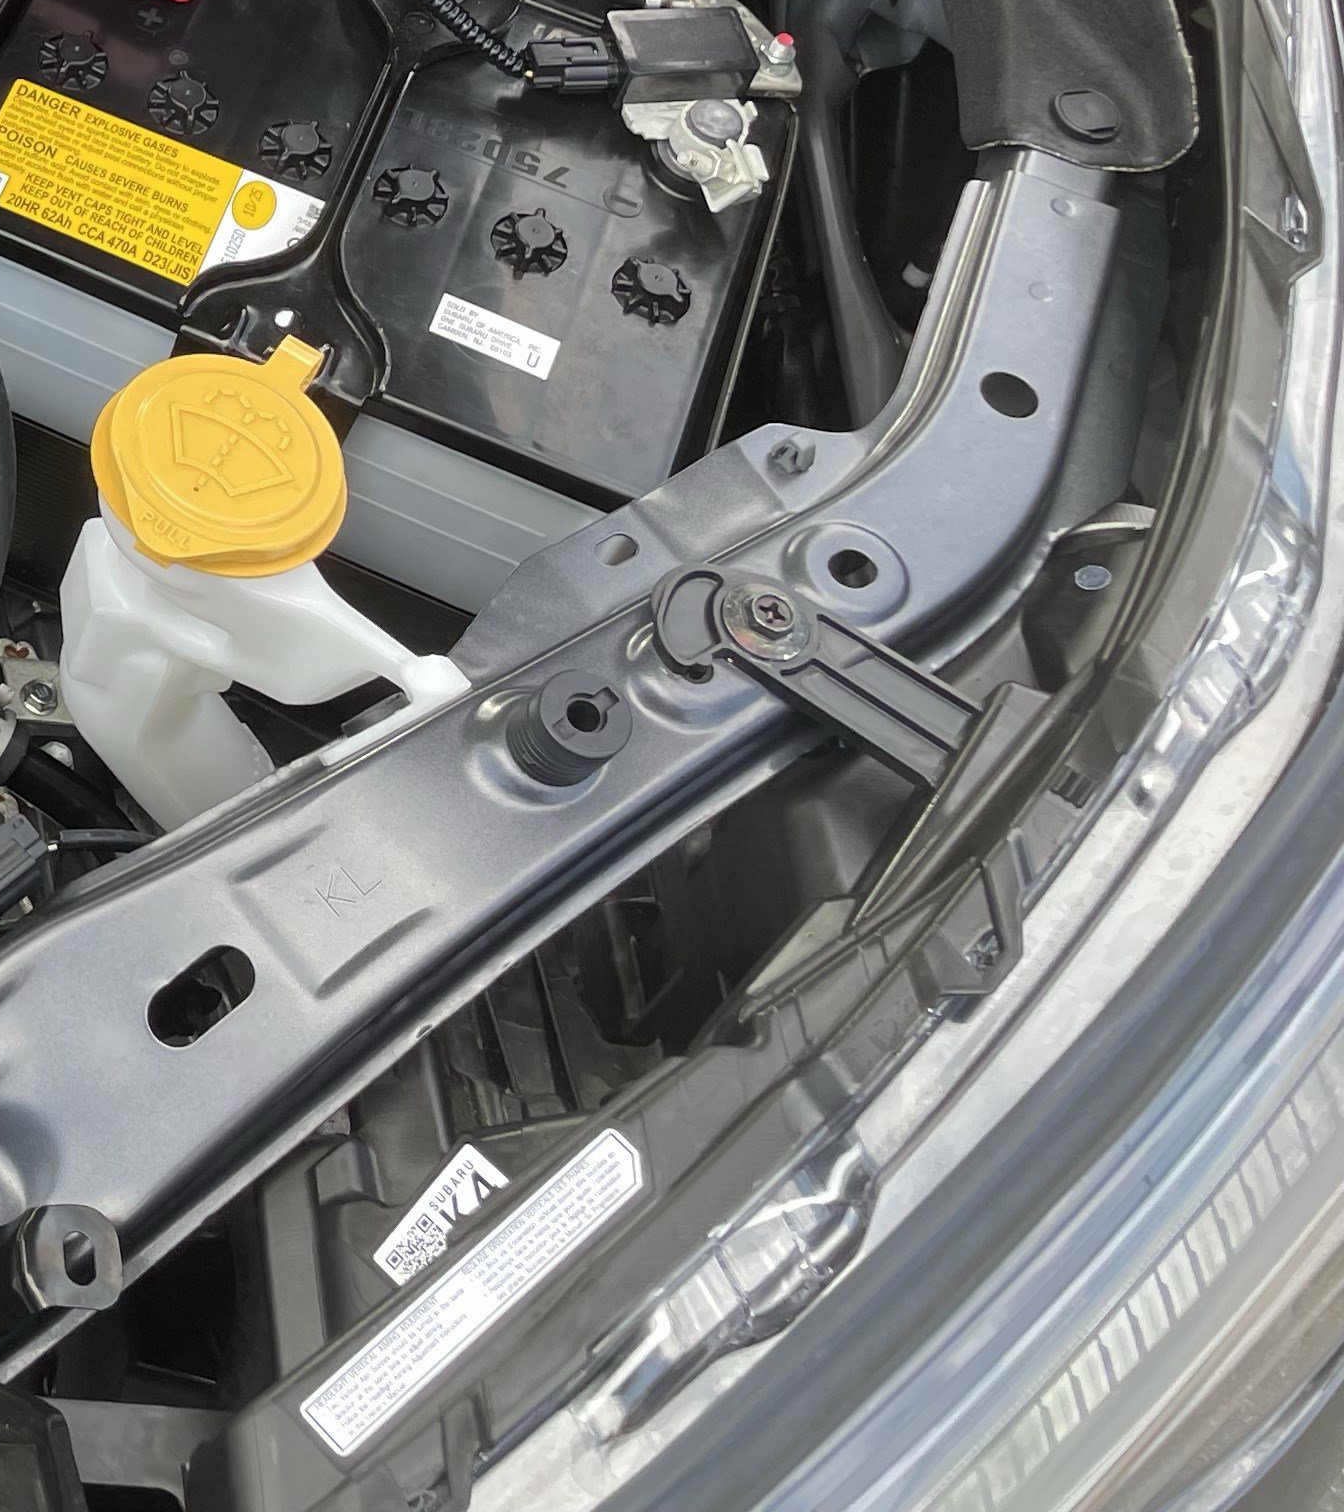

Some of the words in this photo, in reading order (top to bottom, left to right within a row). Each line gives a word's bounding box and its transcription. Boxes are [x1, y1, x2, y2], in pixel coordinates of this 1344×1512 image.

[15, 83, 82, 118] DANGER
[83, 112, 142, 143] EXPLOSIVE
[141, 135, 179, 158] GASES
[24, 171, 55, 191] KEEP
[53, 183, 83, 203] VENT
[82, 195, 113, 216] CAPS
[113, 208, 147, 230] TIGHT
[145, 222, 171, 240] AND
[170, 233, 206, 255] LEVEL
[64, 153, 108, 178] CAUSES
[107, 171, 150, 196] SEVERE
[150, 190, 189, 213] BURNS
[5, 191, 42, 216] 20HR
[39, 206, 74, 230] 62Ah
[76, 221, 108, 244] CCA
[105, 234, 140, 258] 470A
[140, 248, 197, 284] D23(JIS)
[19, 182, 50, 202] KEEP
[48, 194, 74, 212] OUT
[72, 204, 88, 218] OF
[88, 211, 127, 235] REACH
[127, 227, 144, 241] OF
[143, 234, 199, 265] CHILDREN
[524, 351, 540, 368] U
[137, 508, 194, 551] PULL
[429, 1157, 477, 1214] SUBARU
